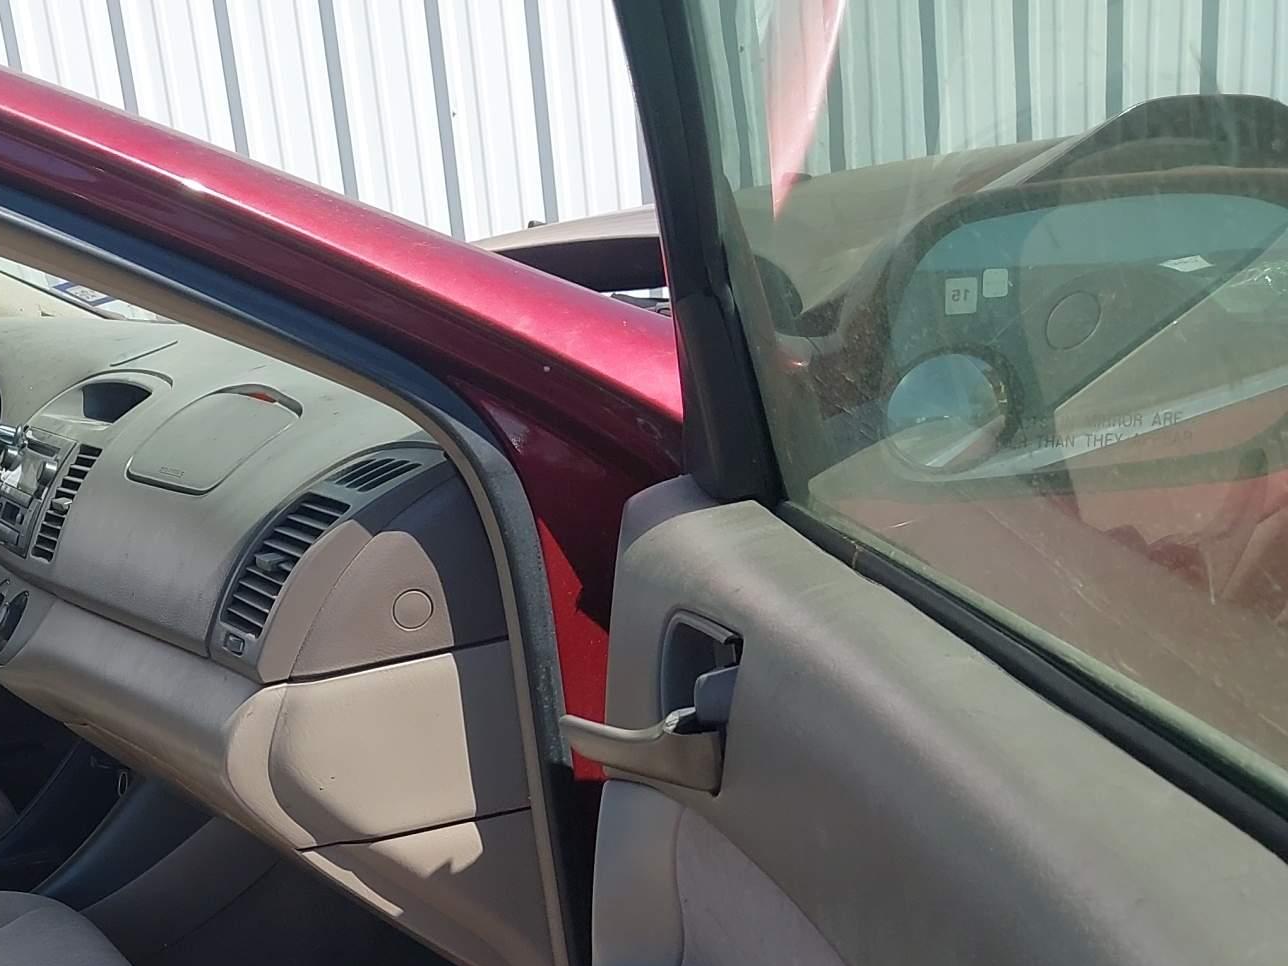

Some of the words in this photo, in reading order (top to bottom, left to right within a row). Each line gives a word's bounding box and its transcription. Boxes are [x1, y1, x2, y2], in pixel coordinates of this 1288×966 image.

[1152, 411, 1184, 425] ARE
[1037, 434, 1076, 449] THAN
[1086, 432, 1123, 448] THEY
